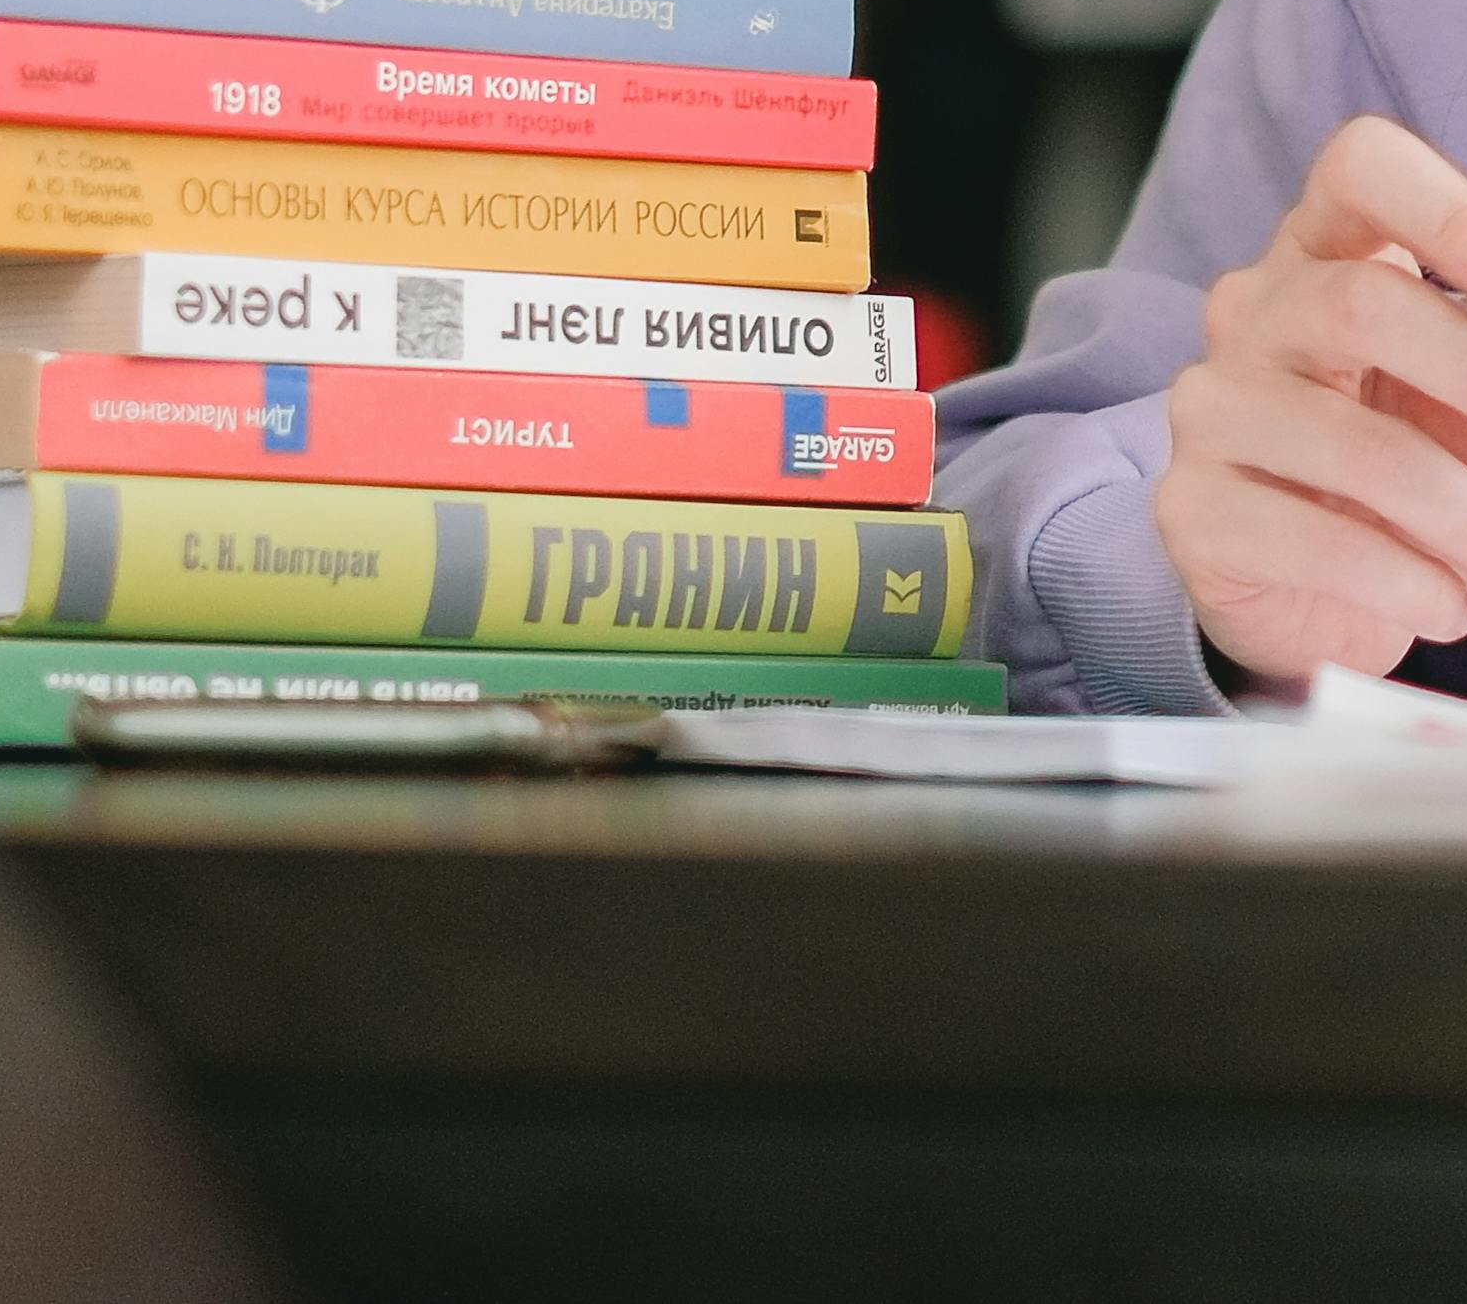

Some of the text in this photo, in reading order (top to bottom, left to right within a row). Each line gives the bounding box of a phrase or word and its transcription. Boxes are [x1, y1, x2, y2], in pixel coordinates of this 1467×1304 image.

[209, 81, 283, 117] 1918
[376, 60, 598, 107] Время кометы
[622, 79, 852, 121] Даниэль Шёнпфлуг
[301, 96, 598, 137] Мир совершает прорыв
[179, 177, 765, 241] ОСНОВЫ КУРСА ИСТОРИИ РОССИИ
[174, 274, 312, 330] реке
[871, 301, 888, 383] GARAGE
[92, 397, 297, 435] Дин Макканелл
[450, 415, 575, 450] ТУРИСТ
[793, 432, 896, 463] GARAGE
[182, 530, 209, 571] С.
[252, 534, 381, 586] Полторак
[523, 525, 818, 635] ГРАНИН
